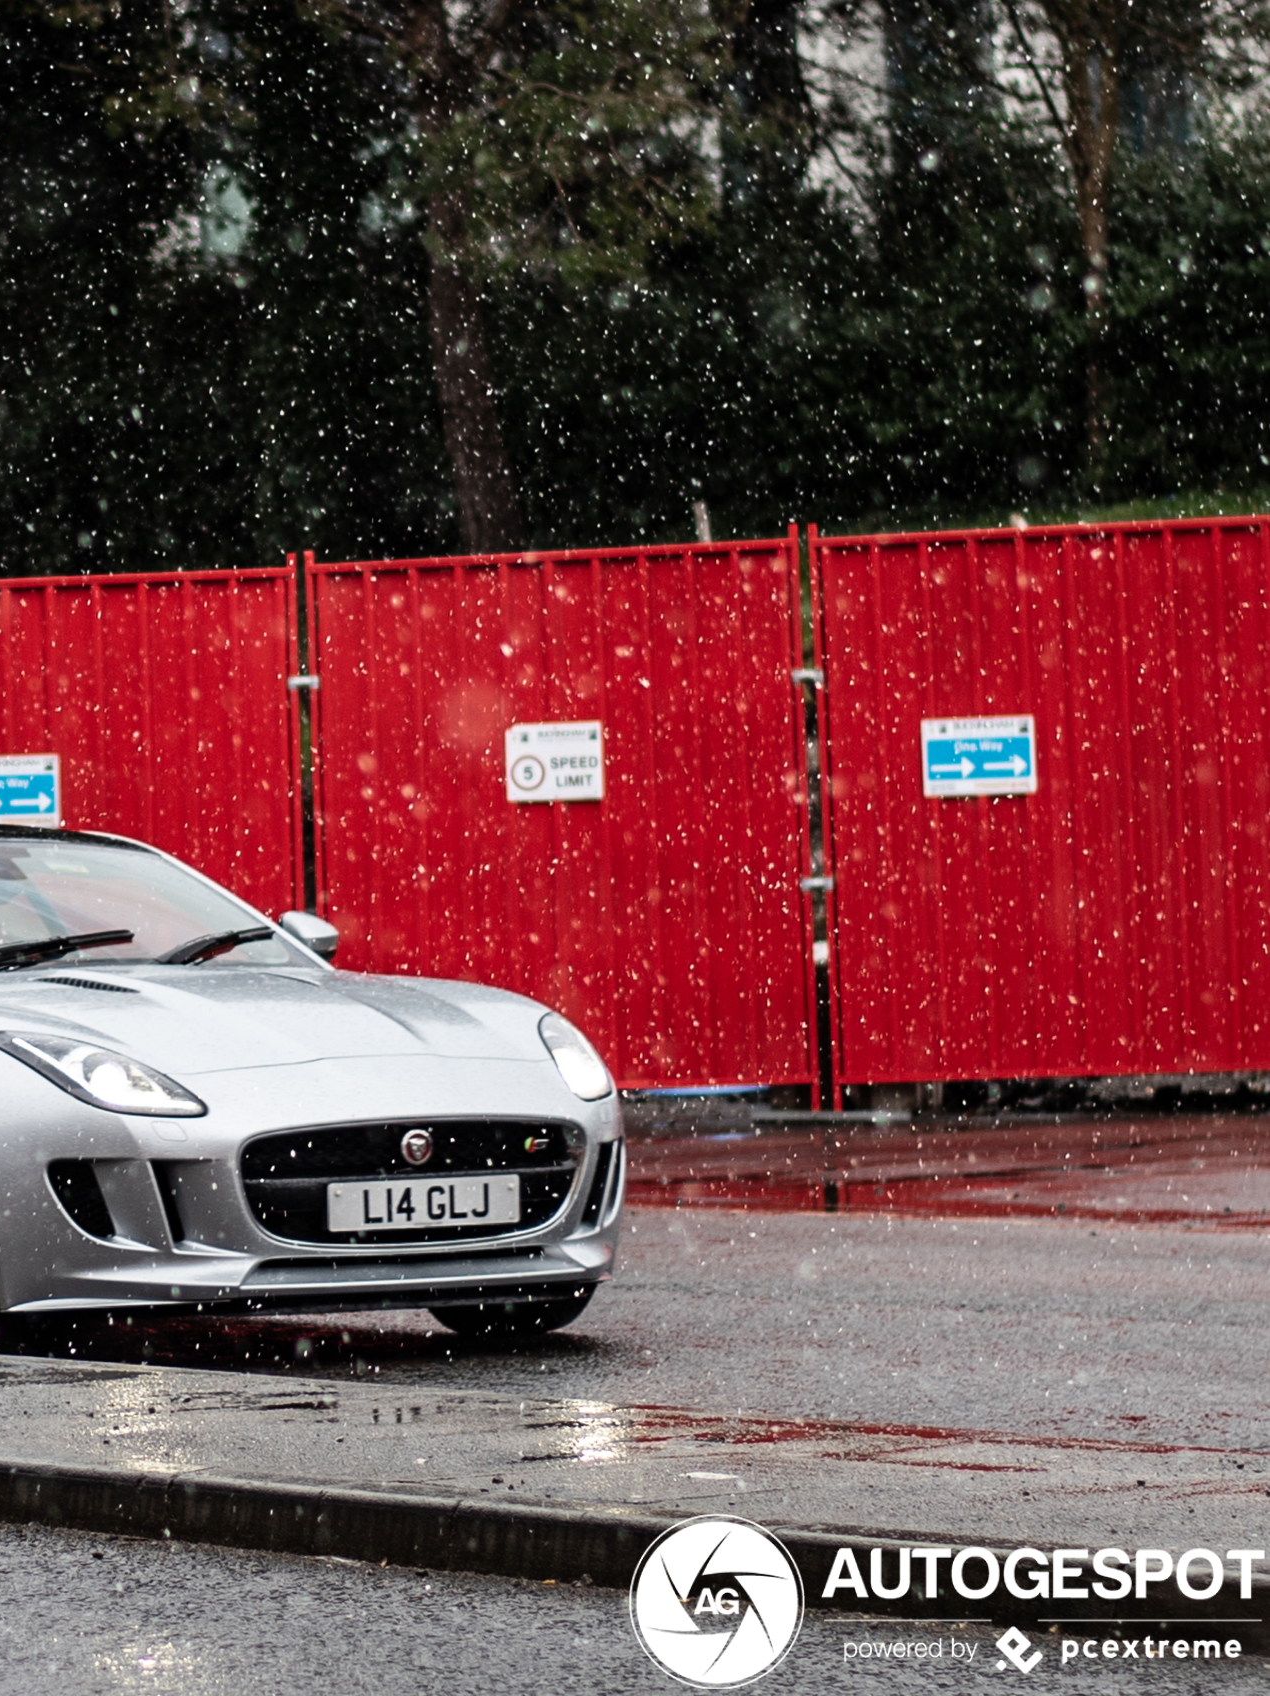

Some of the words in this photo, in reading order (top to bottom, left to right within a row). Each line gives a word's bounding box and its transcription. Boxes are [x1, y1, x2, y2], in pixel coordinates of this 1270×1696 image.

[979, 740, 1003, 753] Way
[550, 756, 599, 769] SPEED
[523, 765, 534, 780] 5
[6, 777, 29, 789] Way
[555, 774, 593, 788] LIMIT
[427, 1183, 490, 1221] GLJ
